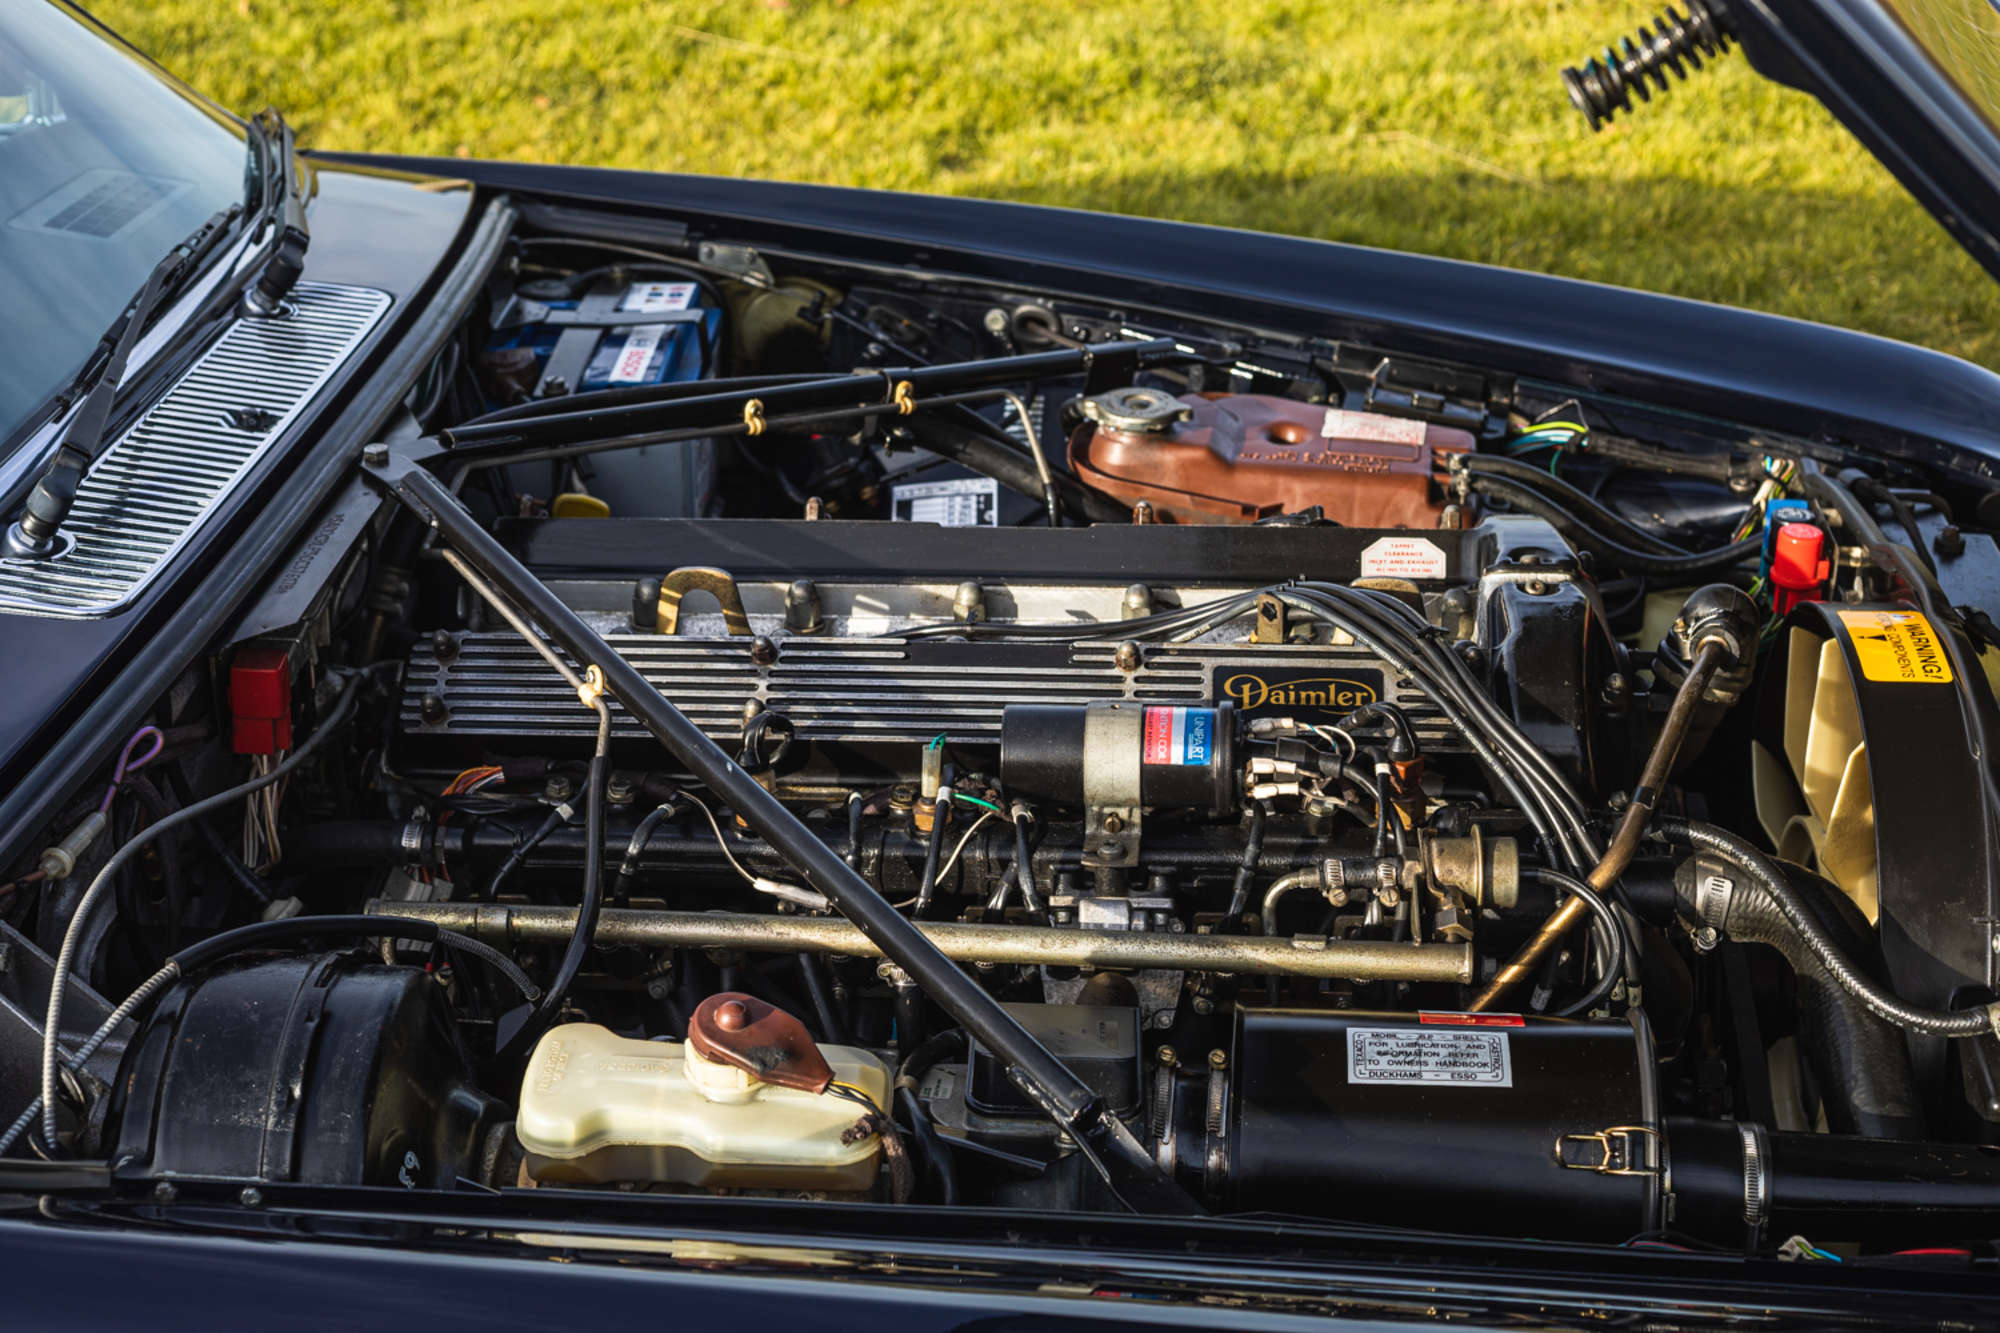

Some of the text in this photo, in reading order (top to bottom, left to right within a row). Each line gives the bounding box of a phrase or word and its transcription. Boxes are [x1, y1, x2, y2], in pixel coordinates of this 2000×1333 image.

[1904, 624, 1943, 680] WARNING!
[1224, 674, 1376, 710] Daimler
[1158, 739, 1167, 761] COIL
[1192, 716, 1205, 761] UNIPART
[1355, 1039, 1363, 1066] TEXACO
[1376, 1050, 1440, 1058] INFORMATION
[1435, 1060, 1490, 1068] HANDBOOK
[1490, 1038, 1501, 1073] CASTROL
[1368, 1071, 1423, 1079] DUCKHAMS
[1450, 1072, 1478, 1080] ESSO
